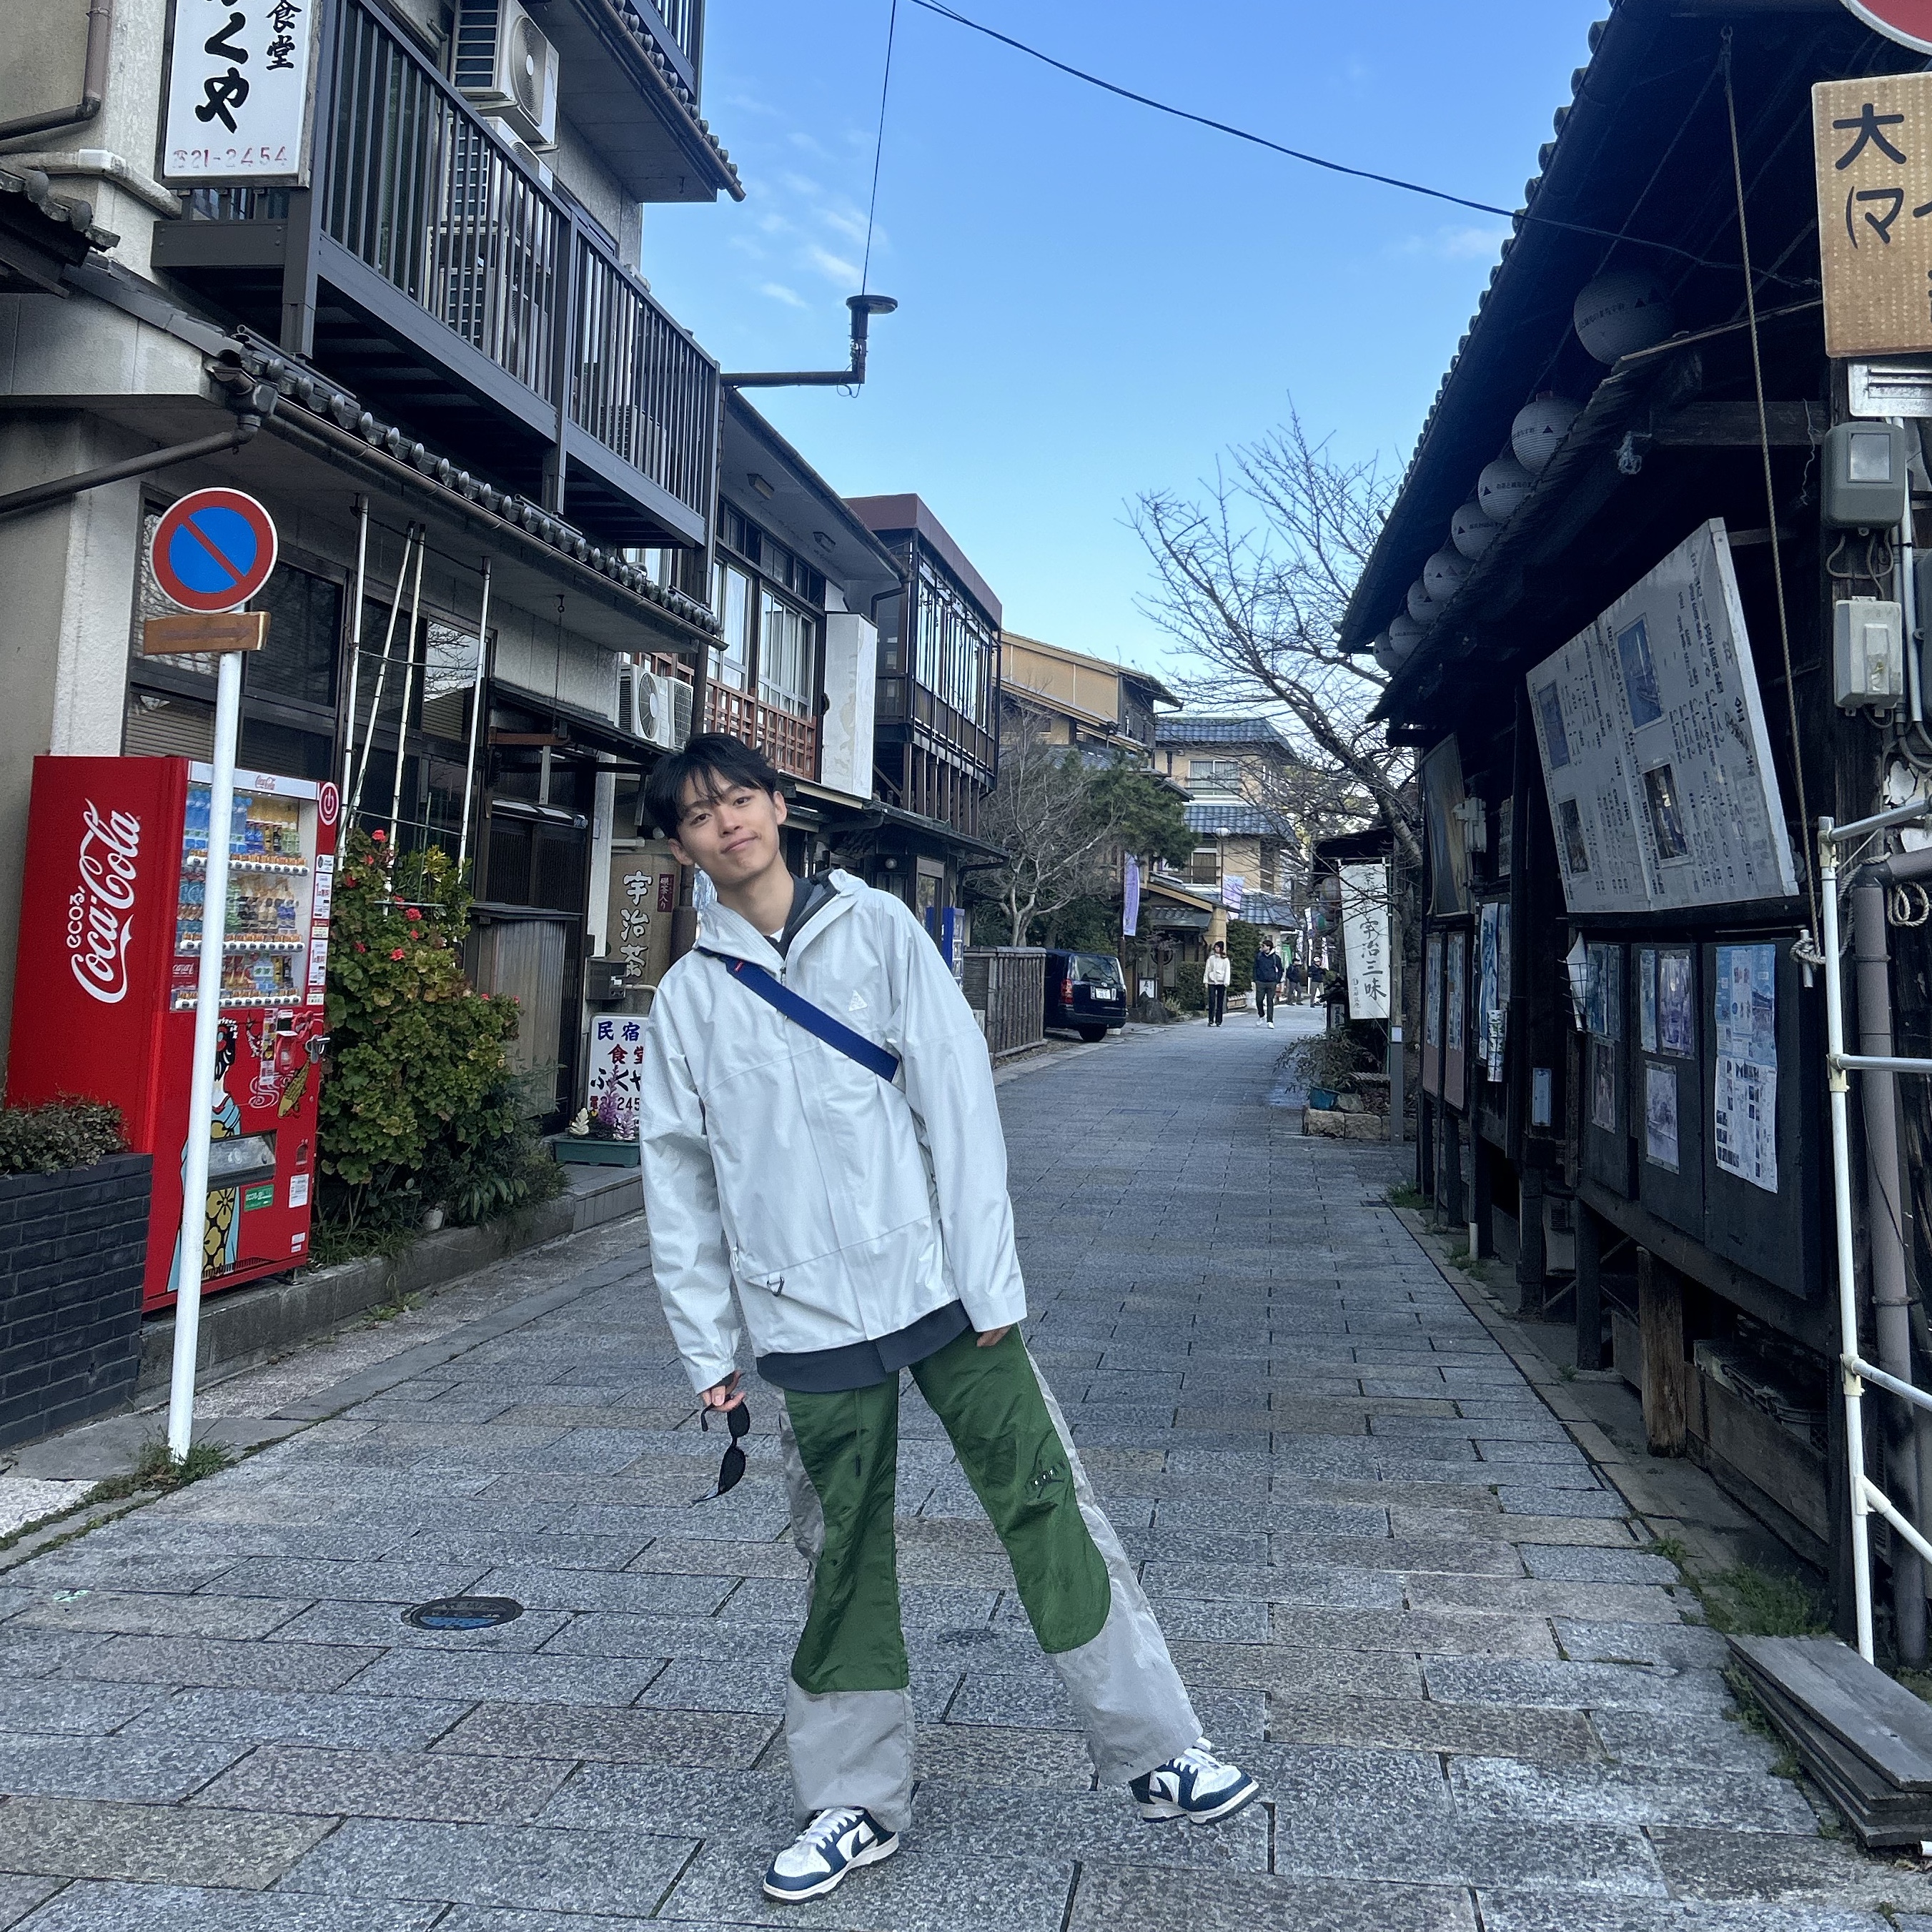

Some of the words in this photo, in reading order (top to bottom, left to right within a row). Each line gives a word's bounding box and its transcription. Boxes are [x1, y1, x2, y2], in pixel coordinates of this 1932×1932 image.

[194, 0, 250, 134] くや
[71, 798, 141, 1004] Coca-Cola
[620, 870, 653, 978] 宇治茶
[598, 1021, 640, 1041] 民宿
